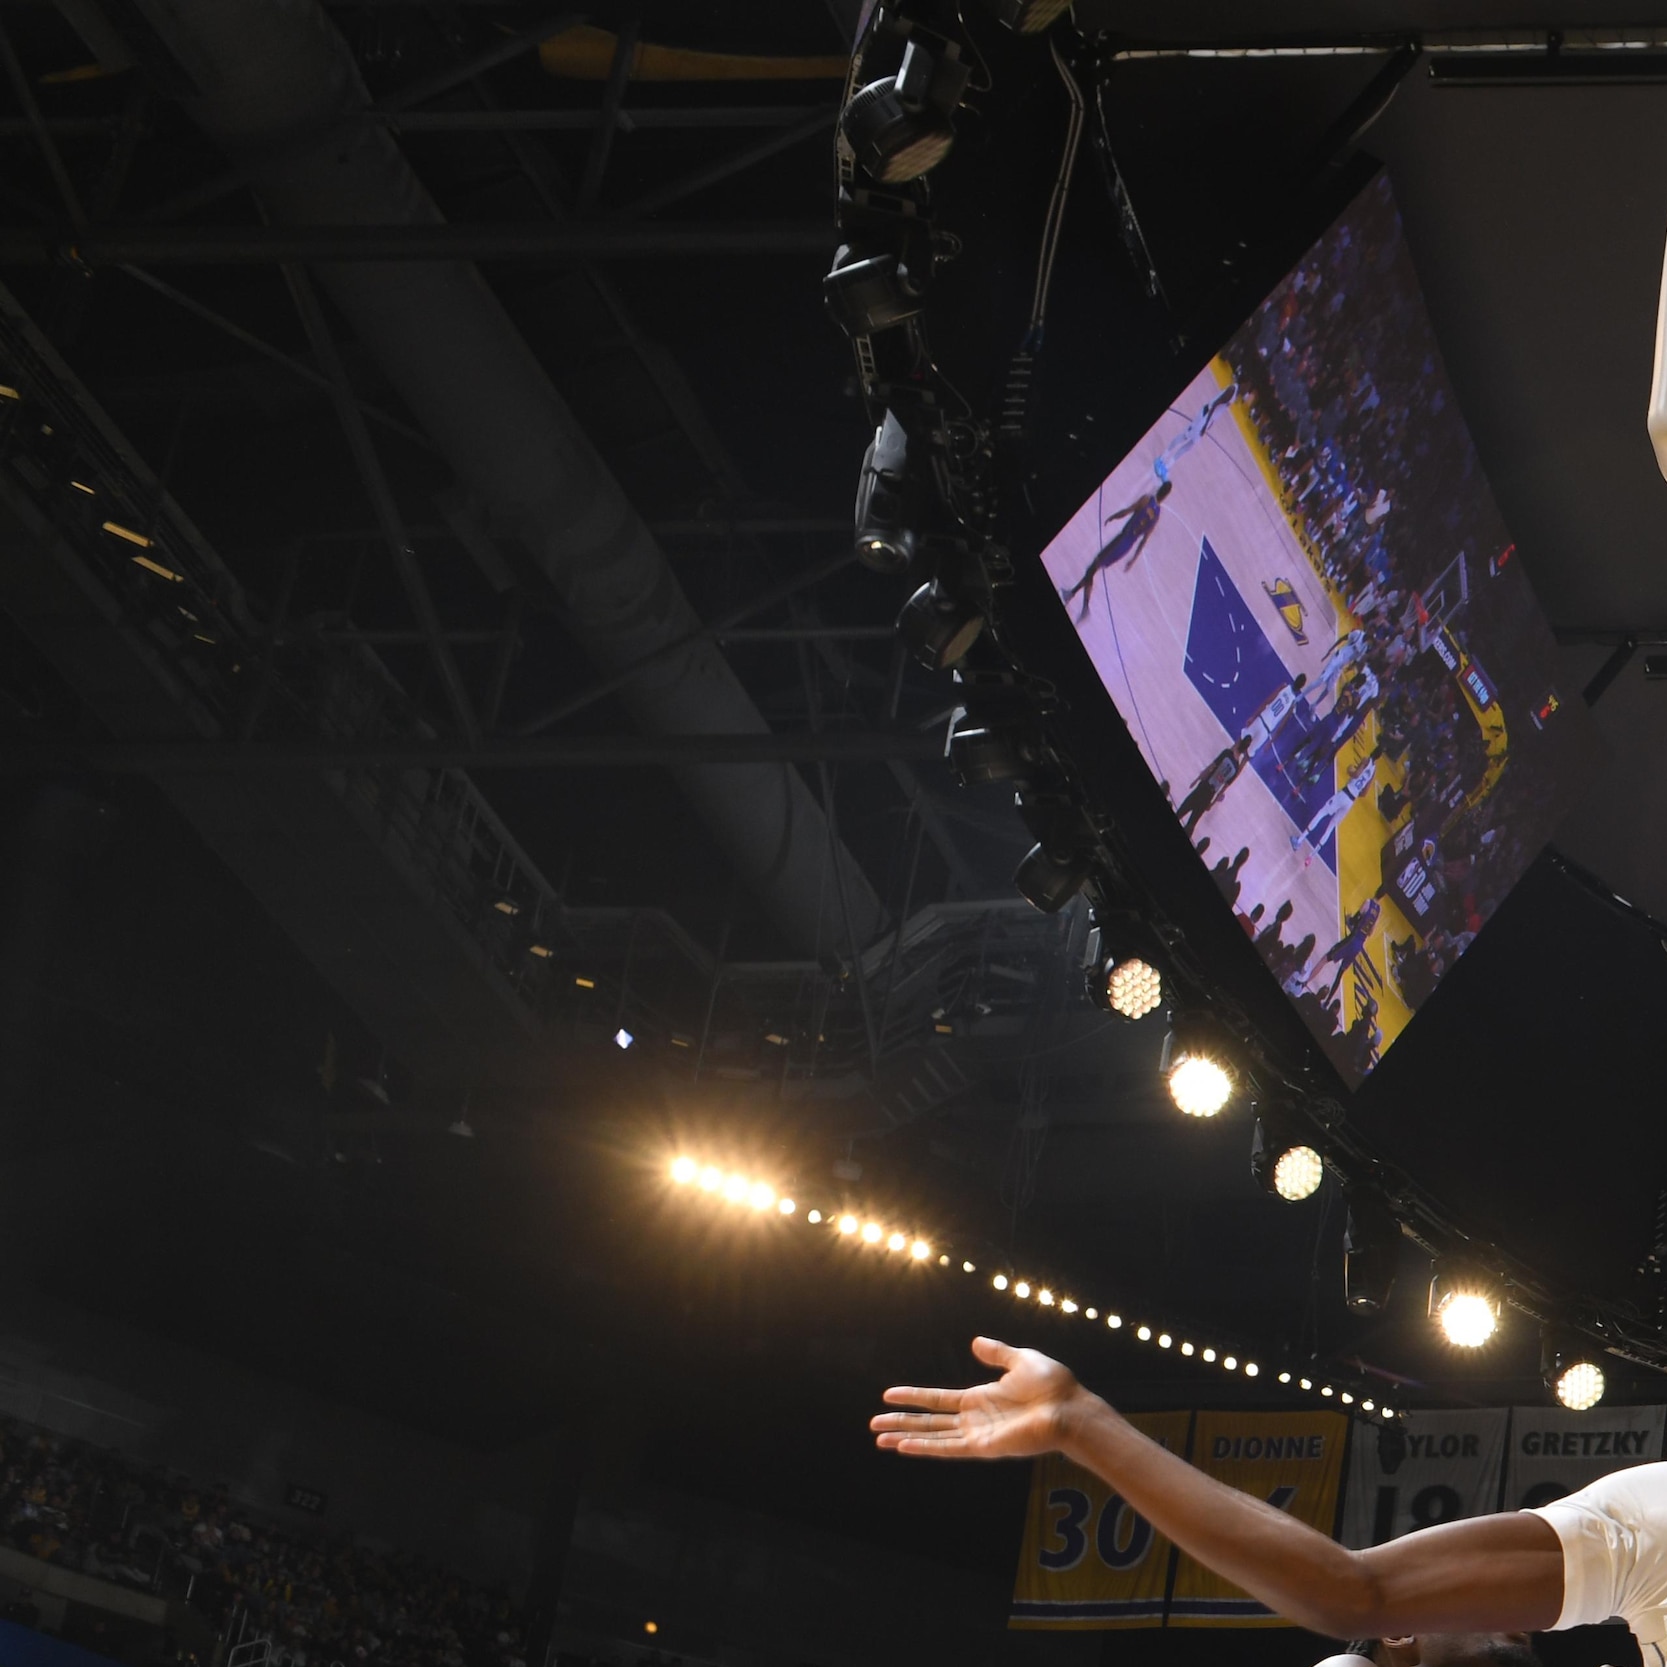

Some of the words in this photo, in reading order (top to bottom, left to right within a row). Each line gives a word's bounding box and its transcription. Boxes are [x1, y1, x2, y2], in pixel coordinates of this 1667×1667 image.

[1213, 1435, 1325, 1461] DIONNE
[1402, 1434, 1480, 1458] YLOR
[1521, 1430, 1650, 1456] GRETZKY
[1038, 1488, 1152, 1573] 30
